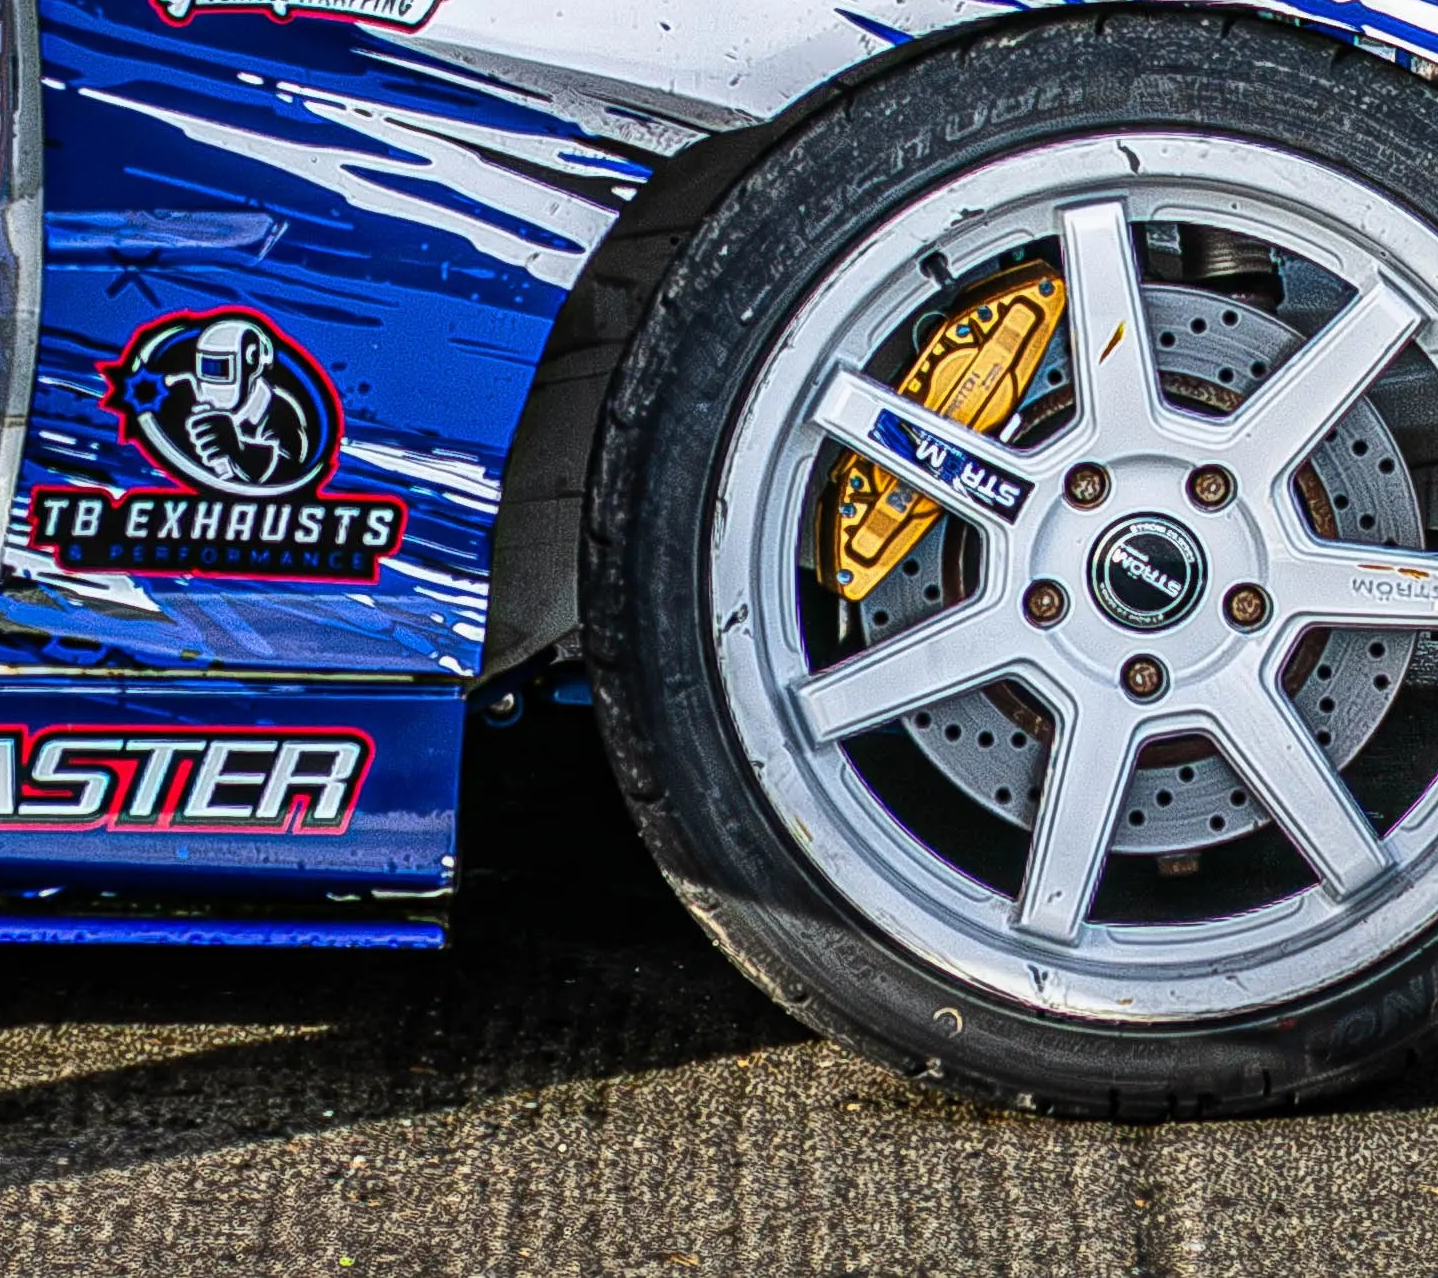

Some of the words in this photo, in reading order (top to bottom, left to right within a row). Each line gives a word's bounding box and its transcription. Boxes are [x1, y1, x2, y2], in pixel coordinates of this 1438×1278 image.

[43, 498, 103, 537] TB
[125, 500, 395, 546] EXHAUSTS
[108, 545, 366, 571] PERFORMANCE
